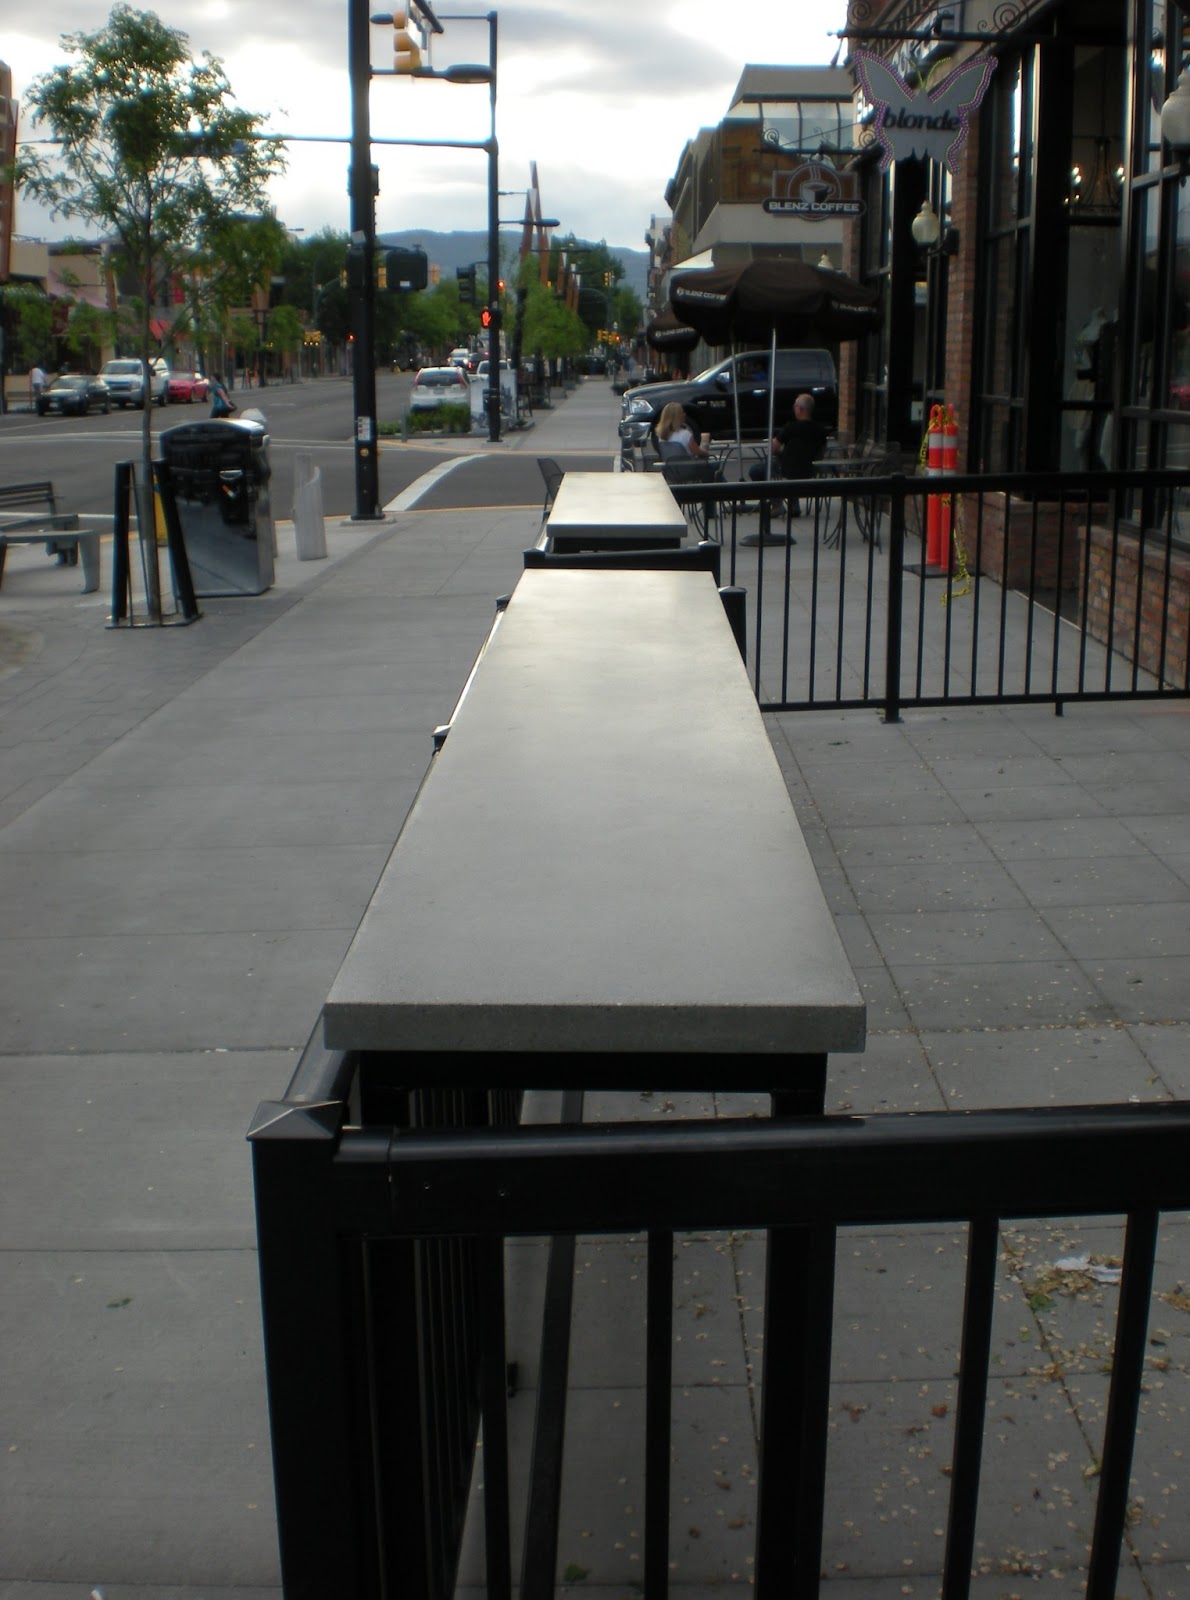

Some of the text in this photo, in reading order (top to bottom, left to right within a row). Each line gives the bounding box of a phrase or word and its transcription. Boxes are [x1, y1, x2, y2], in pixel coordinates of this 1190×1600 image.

[882, 105, 959, 130] blonde
[768, 201, 860, 212] BLENZ COFFEE
